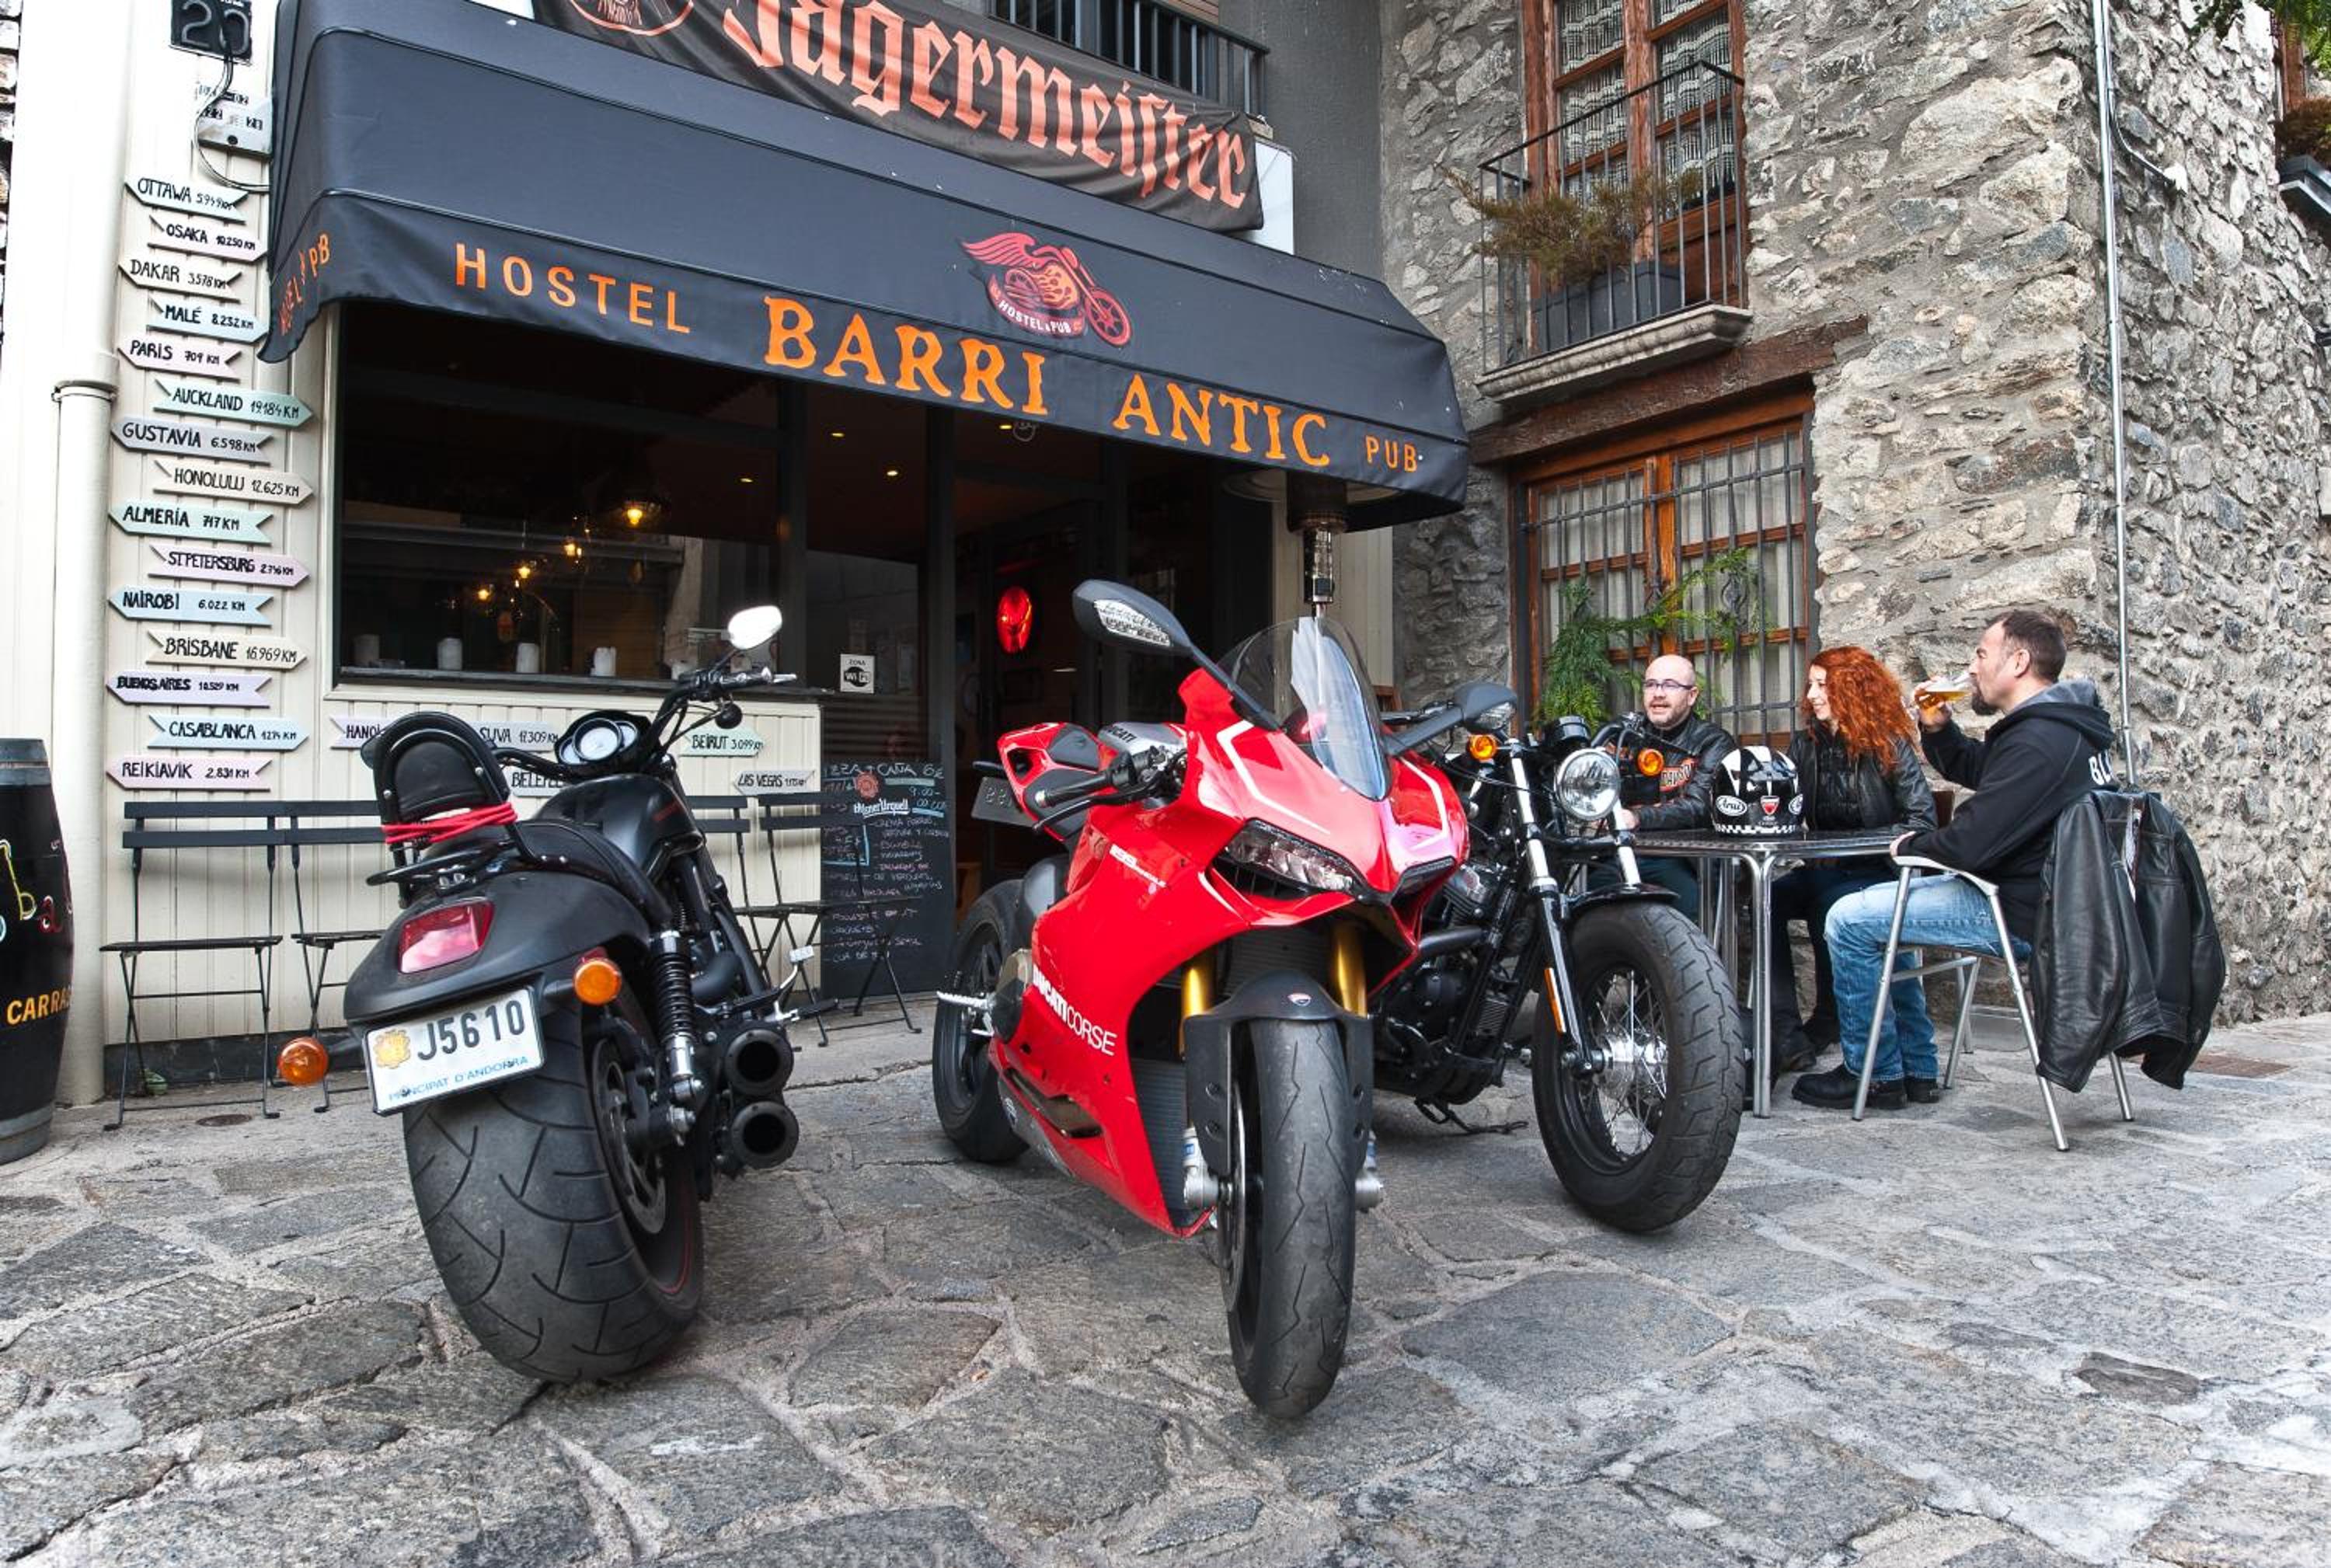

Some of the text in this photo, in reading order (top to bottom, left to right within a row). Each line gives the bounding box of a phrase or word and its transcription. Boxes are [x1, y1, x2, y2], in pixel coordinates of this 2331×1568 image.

[138, 178, 192, 203] OTTAWA
[166, 223, 208, 244] OSAKA
[131, 259, 180, 283] DAKAR
[165, 304, 202, 324] MALÉ
[998, 300, 1044, 330] HOSTEL
[1051, 320, 1071, 333] PUB
[130, 340, 220, 365] PARIS 709 KM
[455, 242, 1417, 472] HOSTEL BARRI ANTIC PUB
[172, 387, 243, 412] AUCKLAND
[284, 404, 299, 419] KM
[122, 422, 201, 448] GUSTAVIA
[174, 468, 299, 497] HONOLULU 12.625 KM
[219, 517, 240, 531] KM
[123, 590, 246, 612] NAIROBI 6.022 KM
[164, 636, 239, 660] BRISBANE
[226, 683, 239, 692] KM
[169, 721, 256, 740] CASABLANCA
[283, 731, 297, 740] KM
[479, 727, 511, 744] SUVA
[692, 733, 730, 750] BEIRUT
[121, 760, 193, 779] REIKIAVIK
[235, 768, 249, 779] KM
[737, 773, 754, 786] LAS
[756, 773, 782, 787] VEGAS
[417, 1000, 525, 1061] J5610
[1066, 1005, 1118, 1057] CORSE
